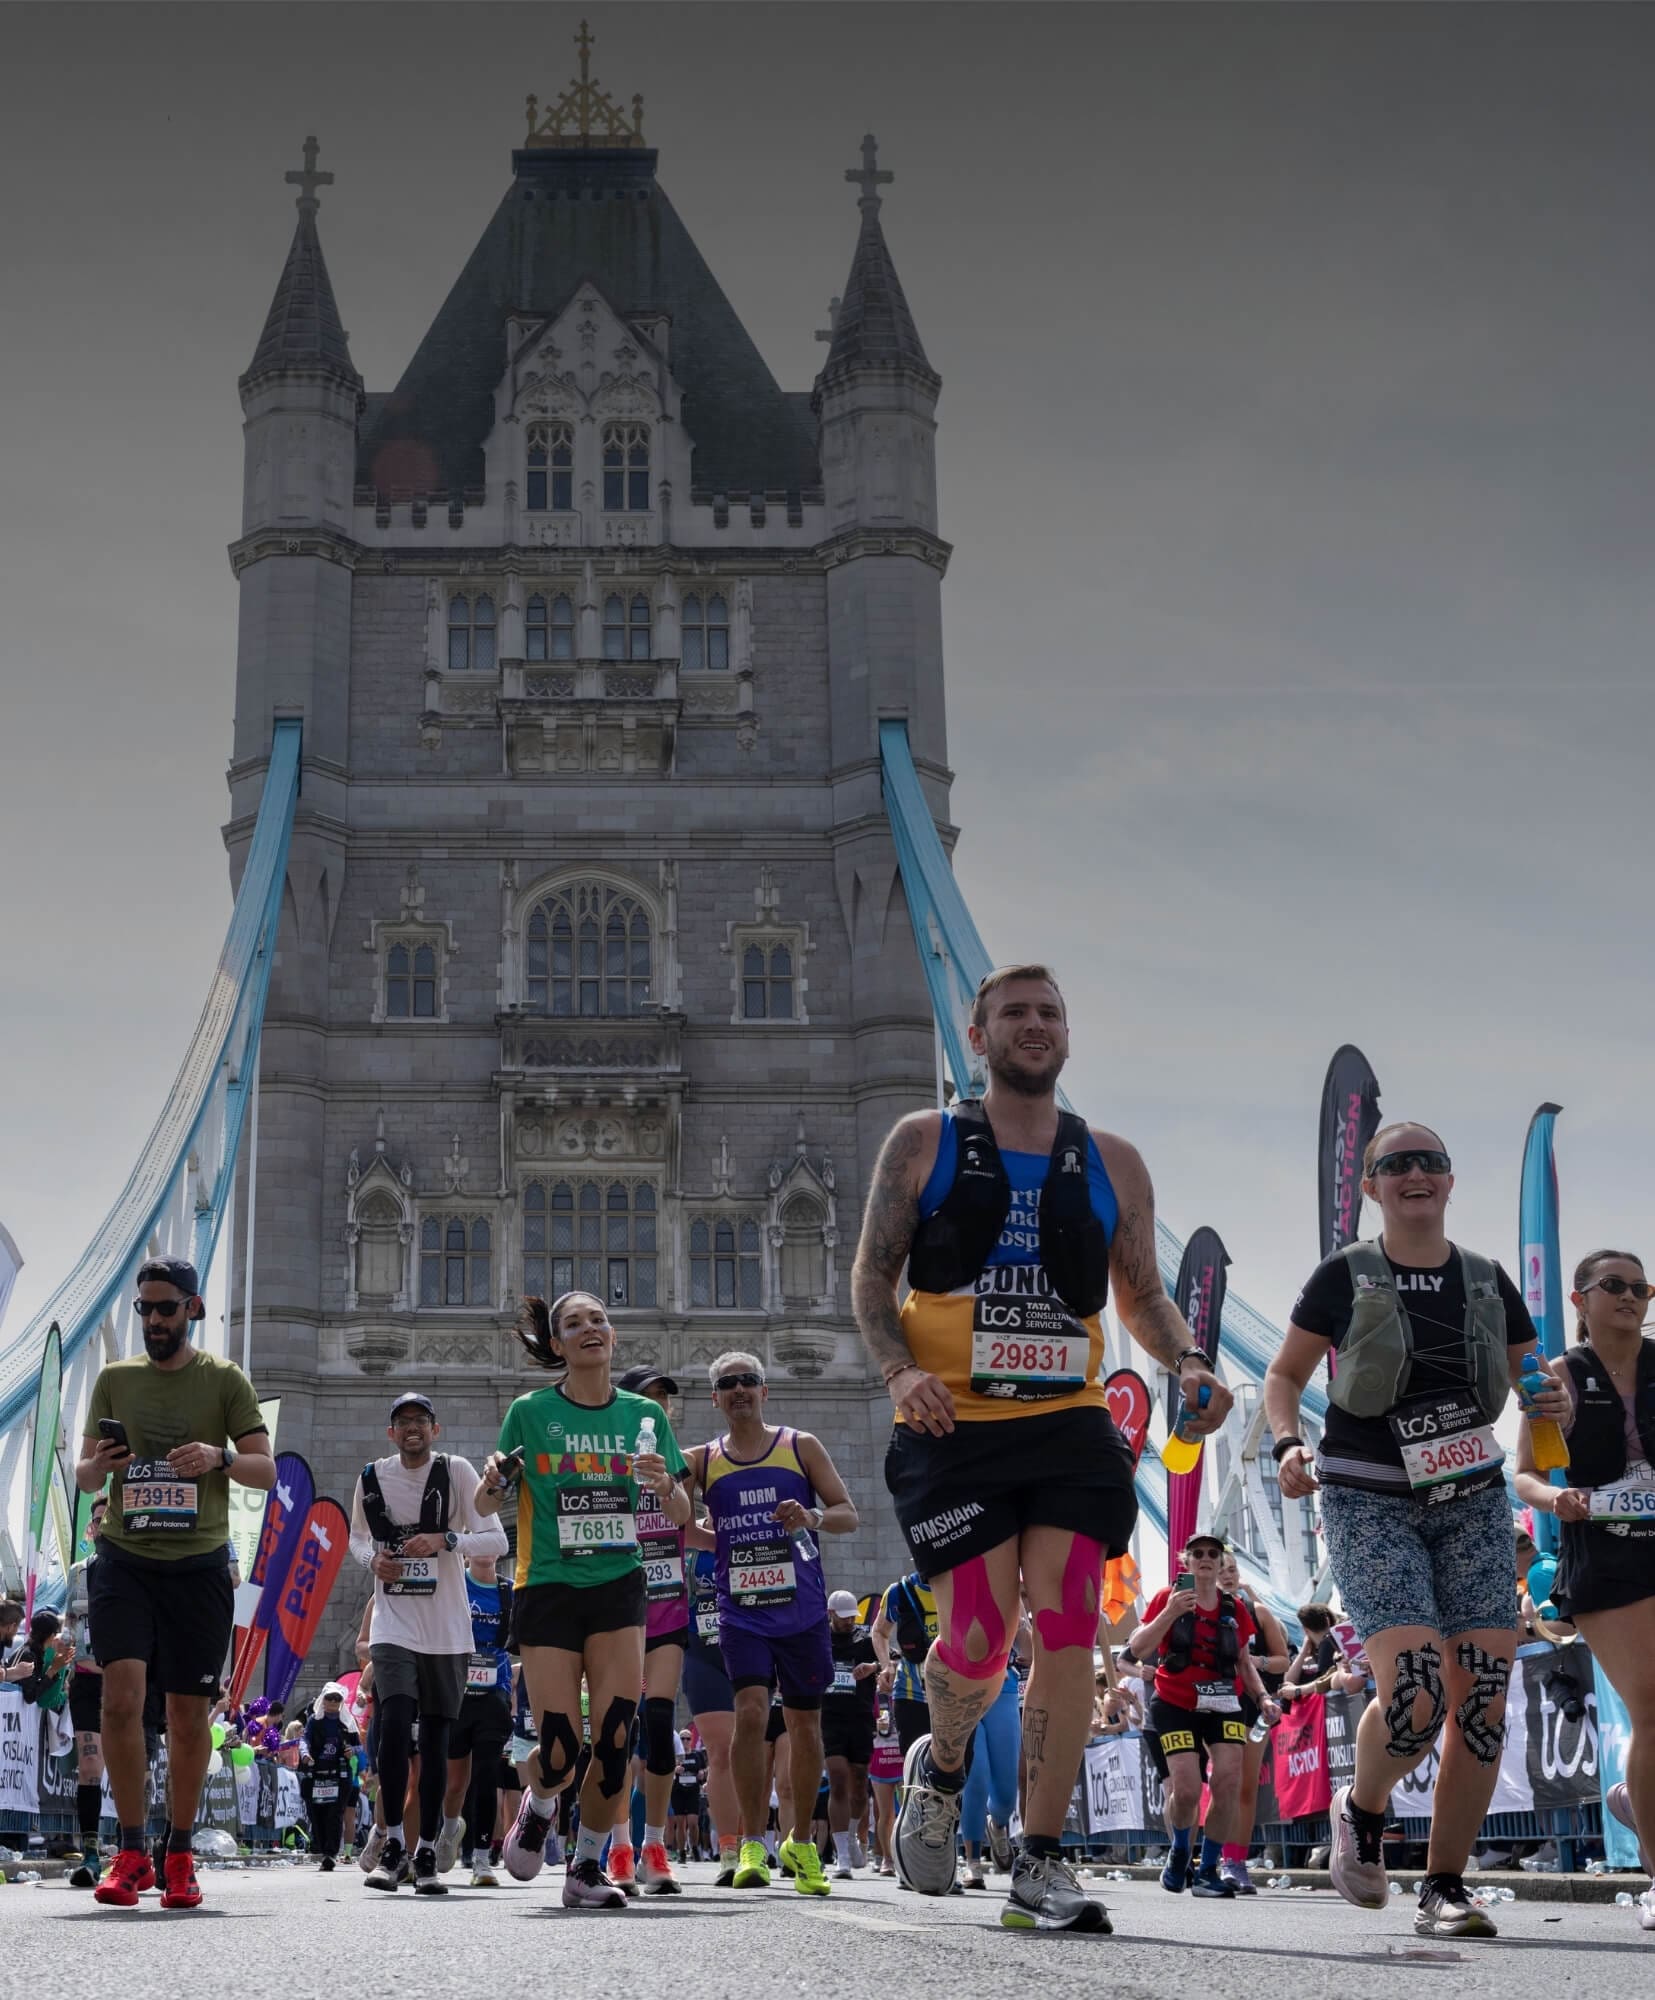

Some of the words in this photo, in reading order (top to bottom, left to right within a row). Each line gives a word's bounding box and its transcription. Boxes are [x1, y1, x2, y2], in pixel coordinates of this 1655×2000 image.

[1340, 1093, 1361, 1236] ACTION
[1396, 1274, 1444, 1292] LILY
[981, 1301, 1021, 1327] tcs
[1026, 1302, 1051, 1311] TATA
[1025, 1320, 1062, 1329] SERVICES
[990, 1342, 1068, 1371] 29831
[1436, 1403, 1458, 1413] TATA
[1397, 1414, 1437, 1439] tcs
[1441, 1417, 1471, 1429] SERVICES
[566, 1434, 627, 1453] HALLE
[1421, 1437, 1489, 1474] 34692
[128, 1464, 151, 1479] tcs
[582, 1473, 613, 1481] LM2026
[133, 1488, 185, 1506] 73915
[561, 1493, 590, 1511] tcs
[739, 1487, 777, 1506] NORM
[1607, 1492, 1655, 1512] 7356
[571, 1520, 624, 1540] 76815
[910, 1502, 984, 1544] GYMSHARK
[729, 1530, 773, 1544] CANCER
[932, 1537, 951, 1550] RUN
[949, 1524, 972, 1541] CLUB
[731, 1550, 754, 1563] tcs
[285, 1540, 323, 1619] PSP
[646, 1563, 673, 1582] 293
[739, 1569, 786, 1588] 24434
[467, 1670, 488, 1682] 741
[1326, 1716, 1345, 1738] TATA
